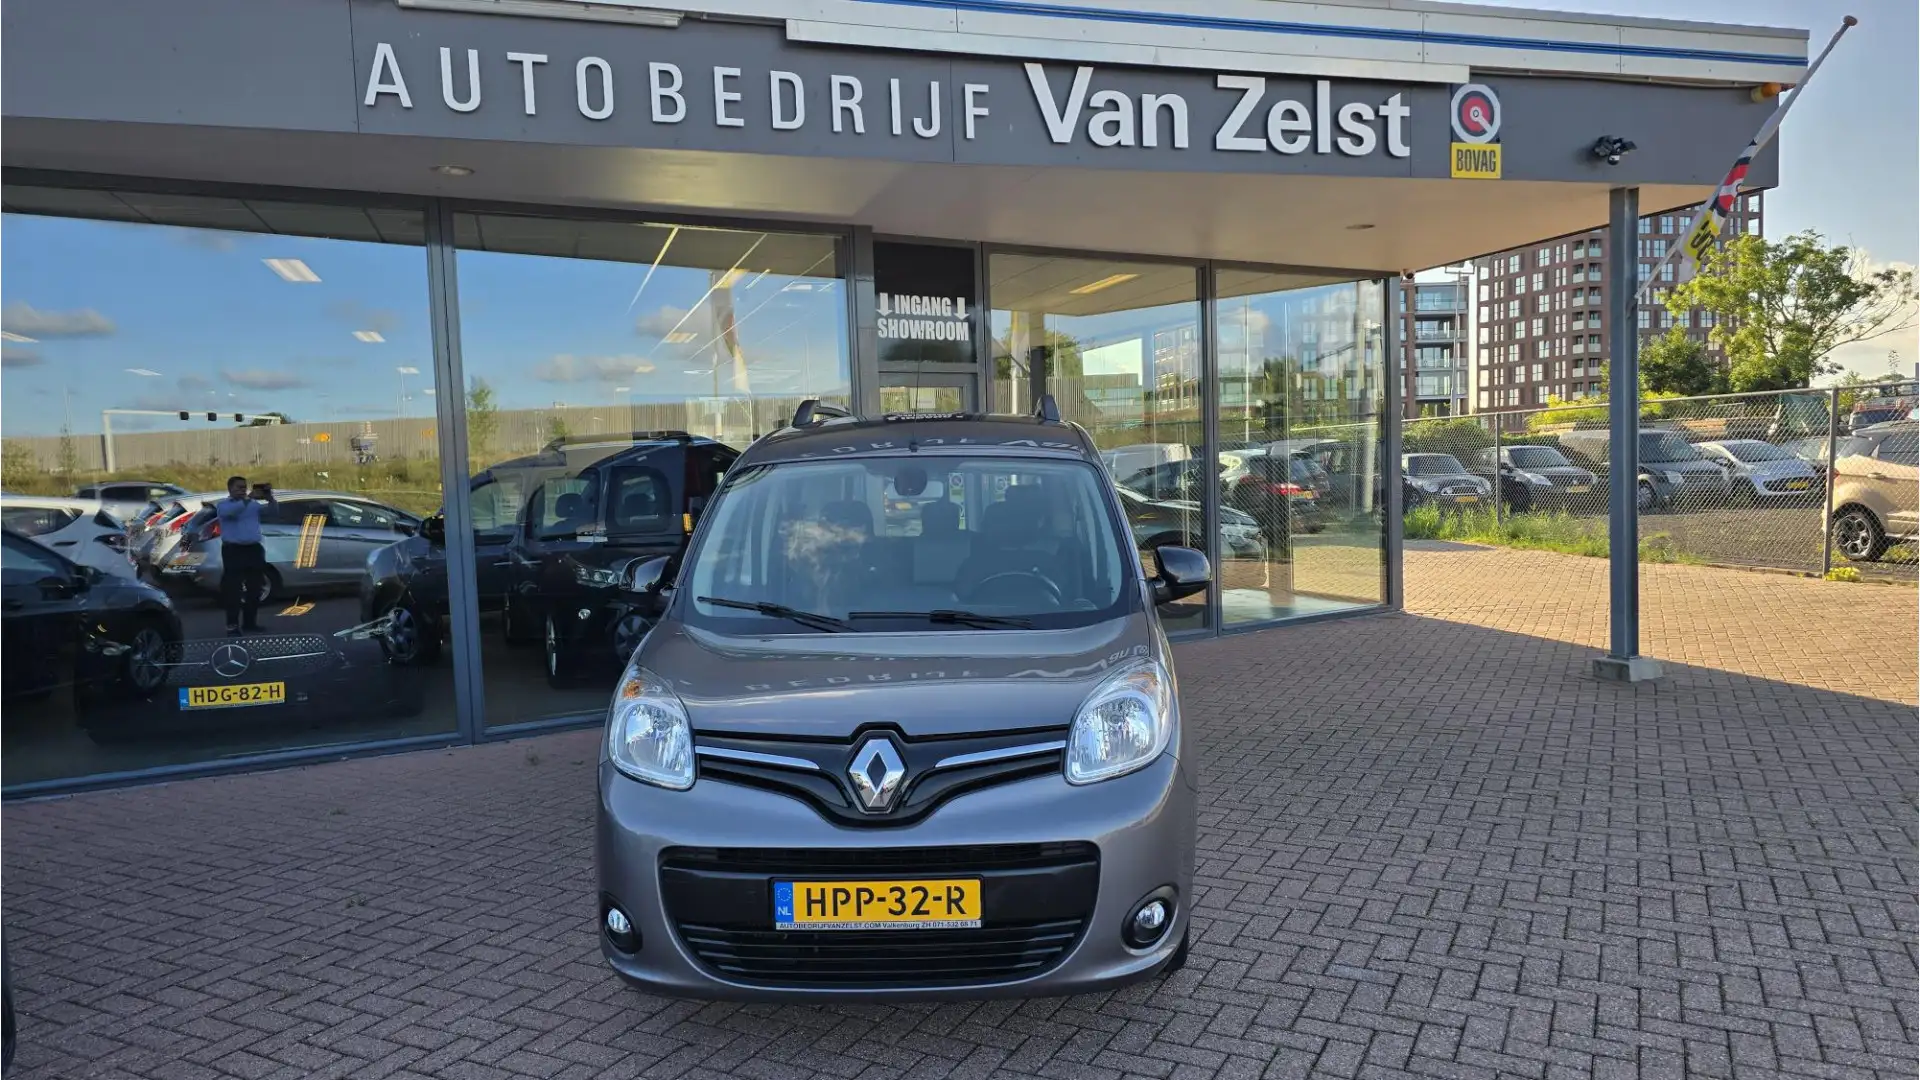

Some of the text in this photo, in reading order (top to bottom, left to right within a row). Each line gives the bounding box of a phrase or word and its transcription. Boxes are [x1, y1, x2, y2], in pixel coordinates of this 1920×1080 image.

[364, 42, 1411, 157] AUTOBEDRIJF Van Zelst
[1455, 148, 1497, 173] BOVAG
[894, 293, 952, 317] INGANG
[877, 318, 969, 341] SHOWROOM
[193, 685, 280, 703] HDG-82-H
[777, 885, 967, 917] NL HPP-32-R
